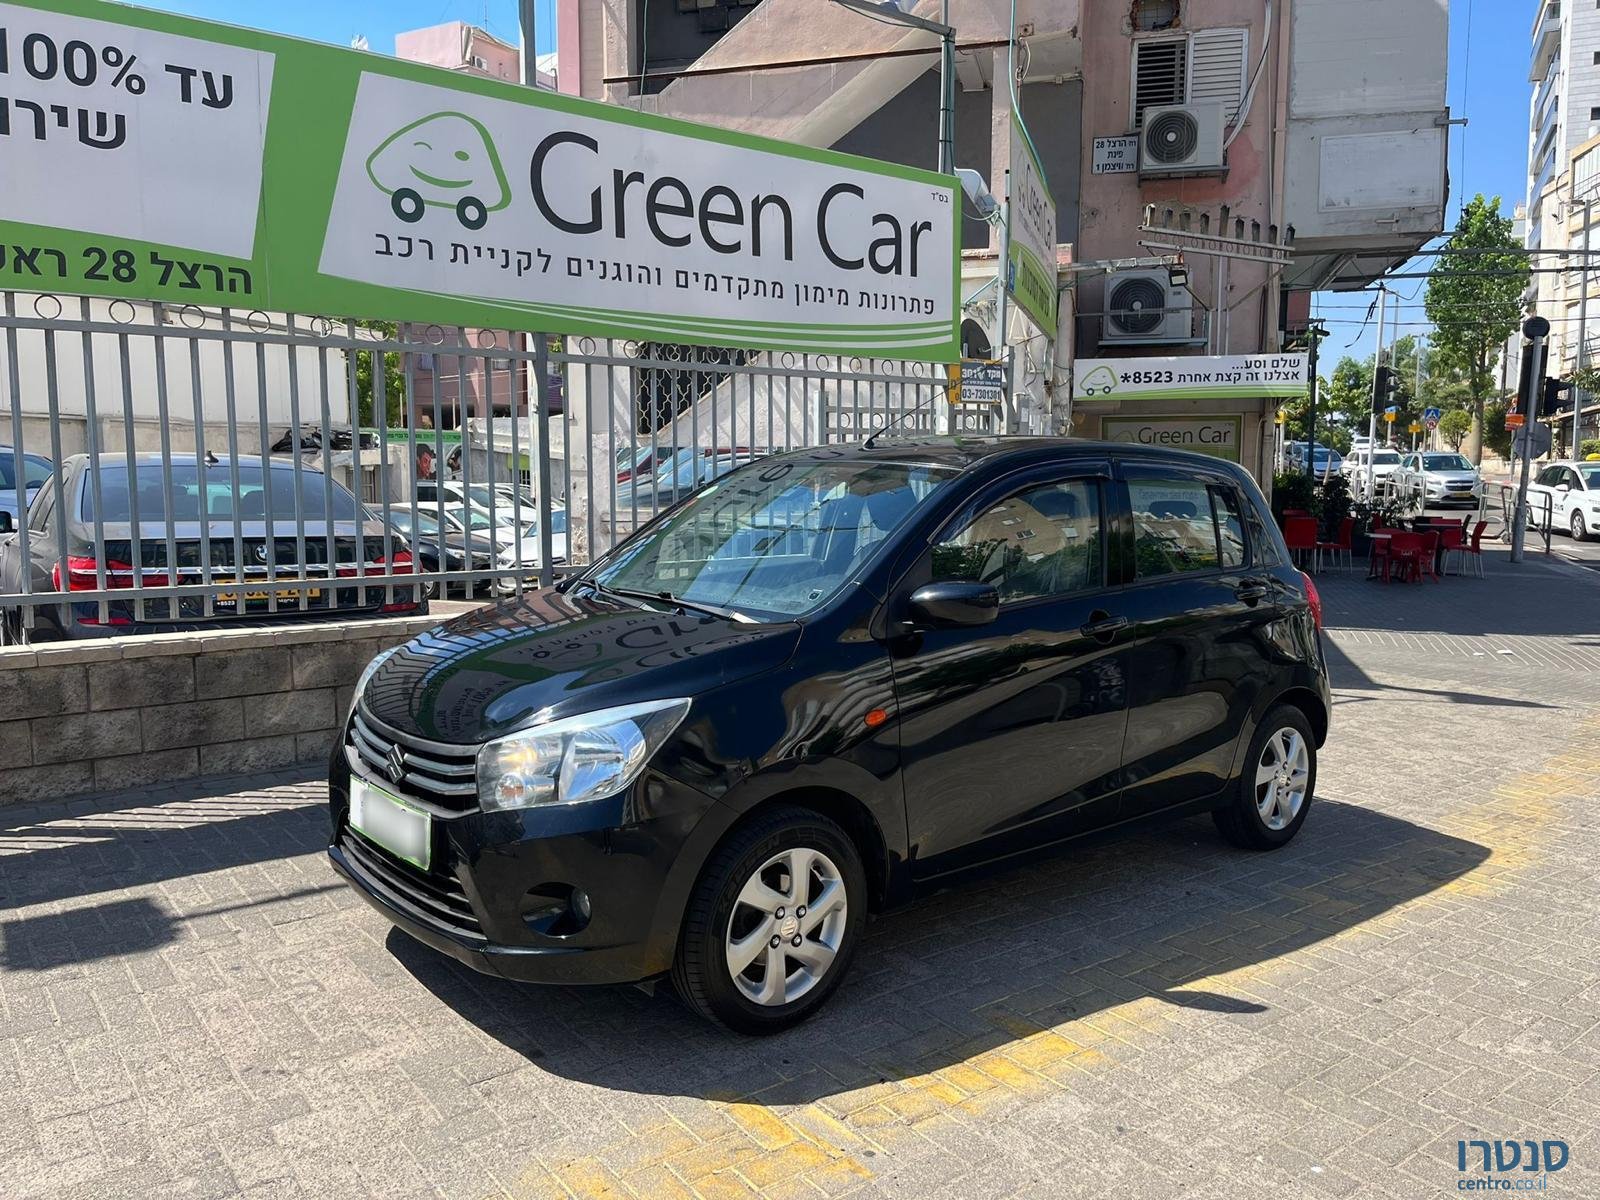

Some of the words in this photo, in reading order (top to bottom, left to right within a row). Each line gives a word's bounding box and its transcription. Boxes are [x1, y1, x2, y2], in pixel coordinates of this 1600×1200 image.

[164, 64, 233, 109] עד
[1107, 139, 1126, 148] הרצל
[1107, 151, 1123, 159] פינת
[530, 131, 793, 261] Green
[817, 183, 932, 277] Car
[375, 234, 434, 260] רכב
[82, 247, 137, 283] 28
[450, 242, 551, 276] לקניית
[150, 251, 252, 294] הרצל
[567, 256, 661, 286] והוגנים
[675, 270, 784, 300] מתקדמים
[795, 284, 849, 306] מימון
[858, 290, 934, 314] פתרונות
[1271, 358, 1300, 368] שלם
[1177, 372, 1210, 383] אחרת
[1215, 372, 1241, 384] קצת
[1246, 372, 1260, 381] זה
[1264, 370, 1300, 381] אצלנו
[1138, 427, 1192, 444] Green
[1198, 426, 1231, 443] Car
